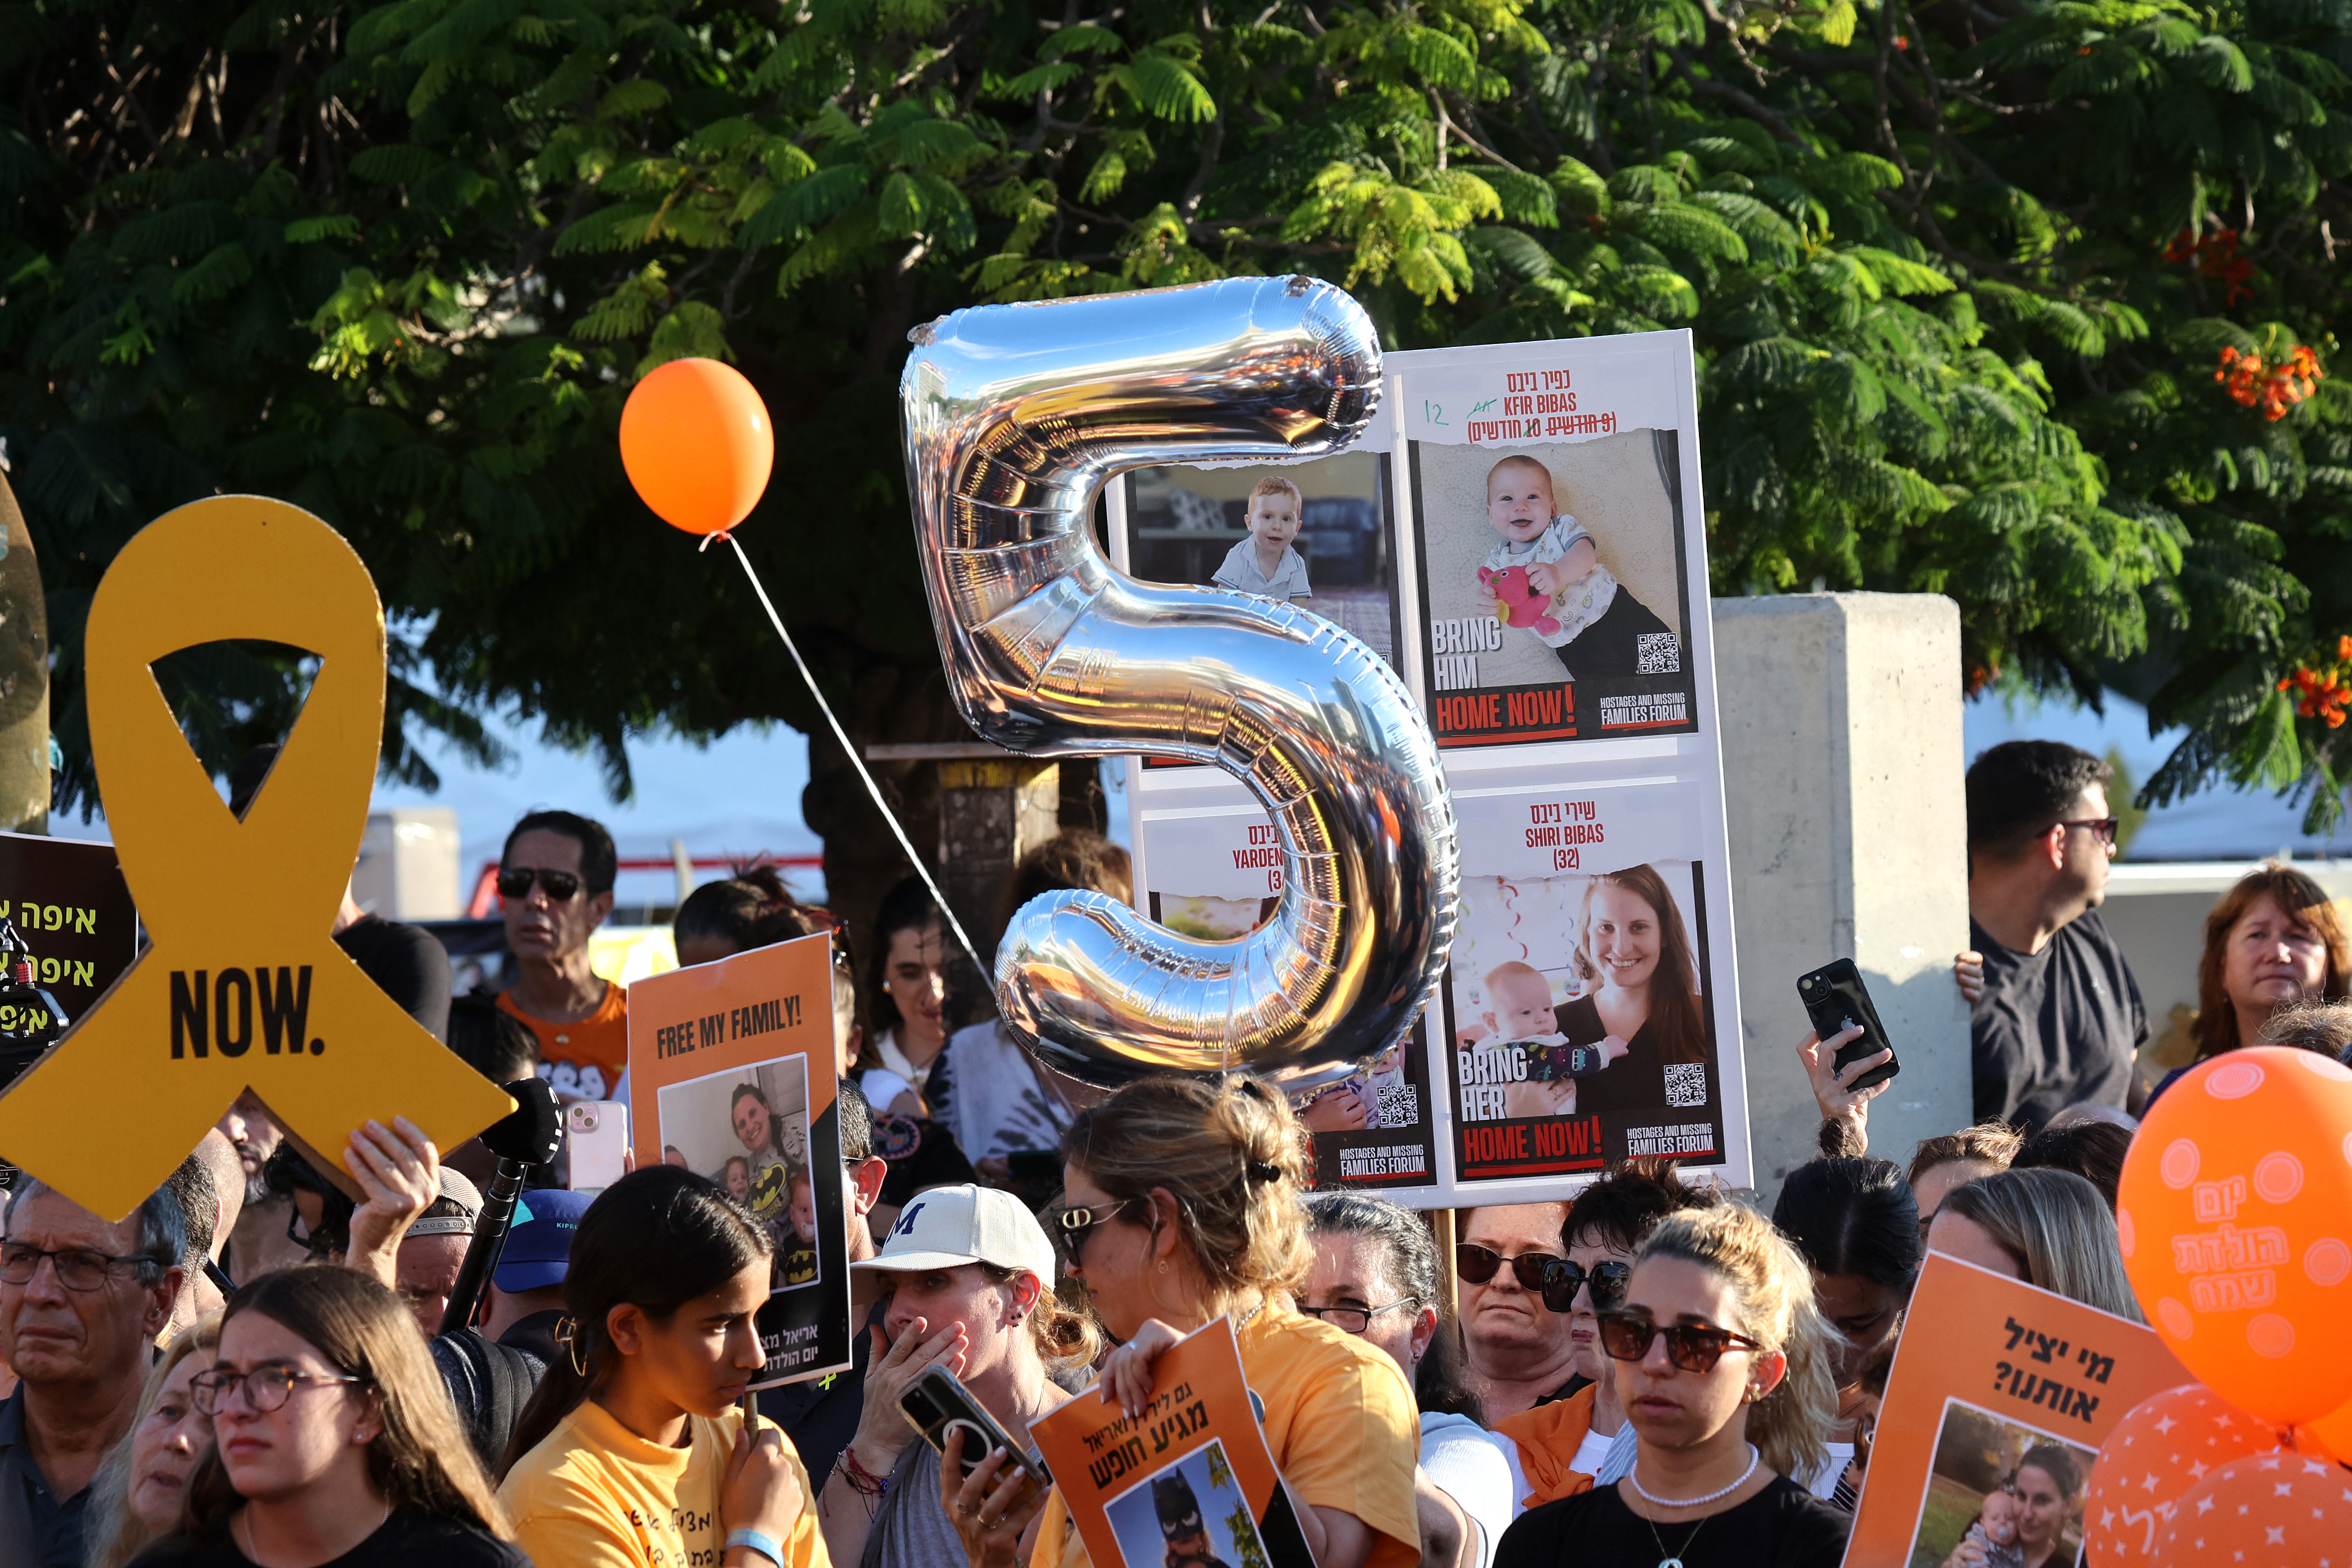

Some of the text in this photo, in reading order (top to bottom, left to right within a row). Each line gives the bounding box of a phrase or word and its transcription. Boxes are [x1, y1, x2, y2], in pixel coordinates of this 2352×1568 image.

[1507, 369, 1571, 393] כפיר ביבס
[1425, 400, 1449, 426] 12
[1504, 392, 1577, 416] KFIR BIBAS
[1431, 616, 1501, 654] BRING
[1433, 655, 1478, 691] HIM
[1436, 684, 1576, 731] HOME NOW!
[1600, 692, 1685, 708] HOSTAGES AND MISSING
[1601, 704, 1687, 725] FAMILIES FORUM
[1530, 801, 1595, 824] שירי ביבס
[1525, 823, 1604, 848] SHIRI BIBAS
[1232, 847, 1283, 869] YARDEN
[1553, 847, 1580, 871] (32)
[1268, 869, 1284, 892] (3
[21, 902, 96, 935] איפה
[170, 965, 325, 1060] NOW.
[657, 994, 802, 1060] FREE MY FAMILY!
[1458, 1047, 1528, 1084] BRING
[1461, 1086, 1506, 1121] HER
[1464, 1115, 1603, 1162] HOME NOW!
[1627, 1123, 1712, 1139] HOSTAGES AND MISSING
[1340, 1144, 1424, 1160] HOSTAGES AND MISSING
[1628, 1135, 1713, 1156] FAMILIES FORUM
[1340, 1155, 1425, 1176] FAMILIES FORUM
[2196, 1178, 2245, 1219] יום
[2174, 1226, 2287, 1271] הולדת
[2192, 1271, 2274, 1310] שמח
[783, 1324, 818, 1346] אריאל
[763, 1346, 818, 1372] יום הולדת
[2005, 1316, 2114, 1384] מי יציל
[1174, 1382, 1193, 1405] גם
[1994, 1361, 2100, 1423] אותנו?
[1088, 1400, 1209, 1490] מגיע חופש
